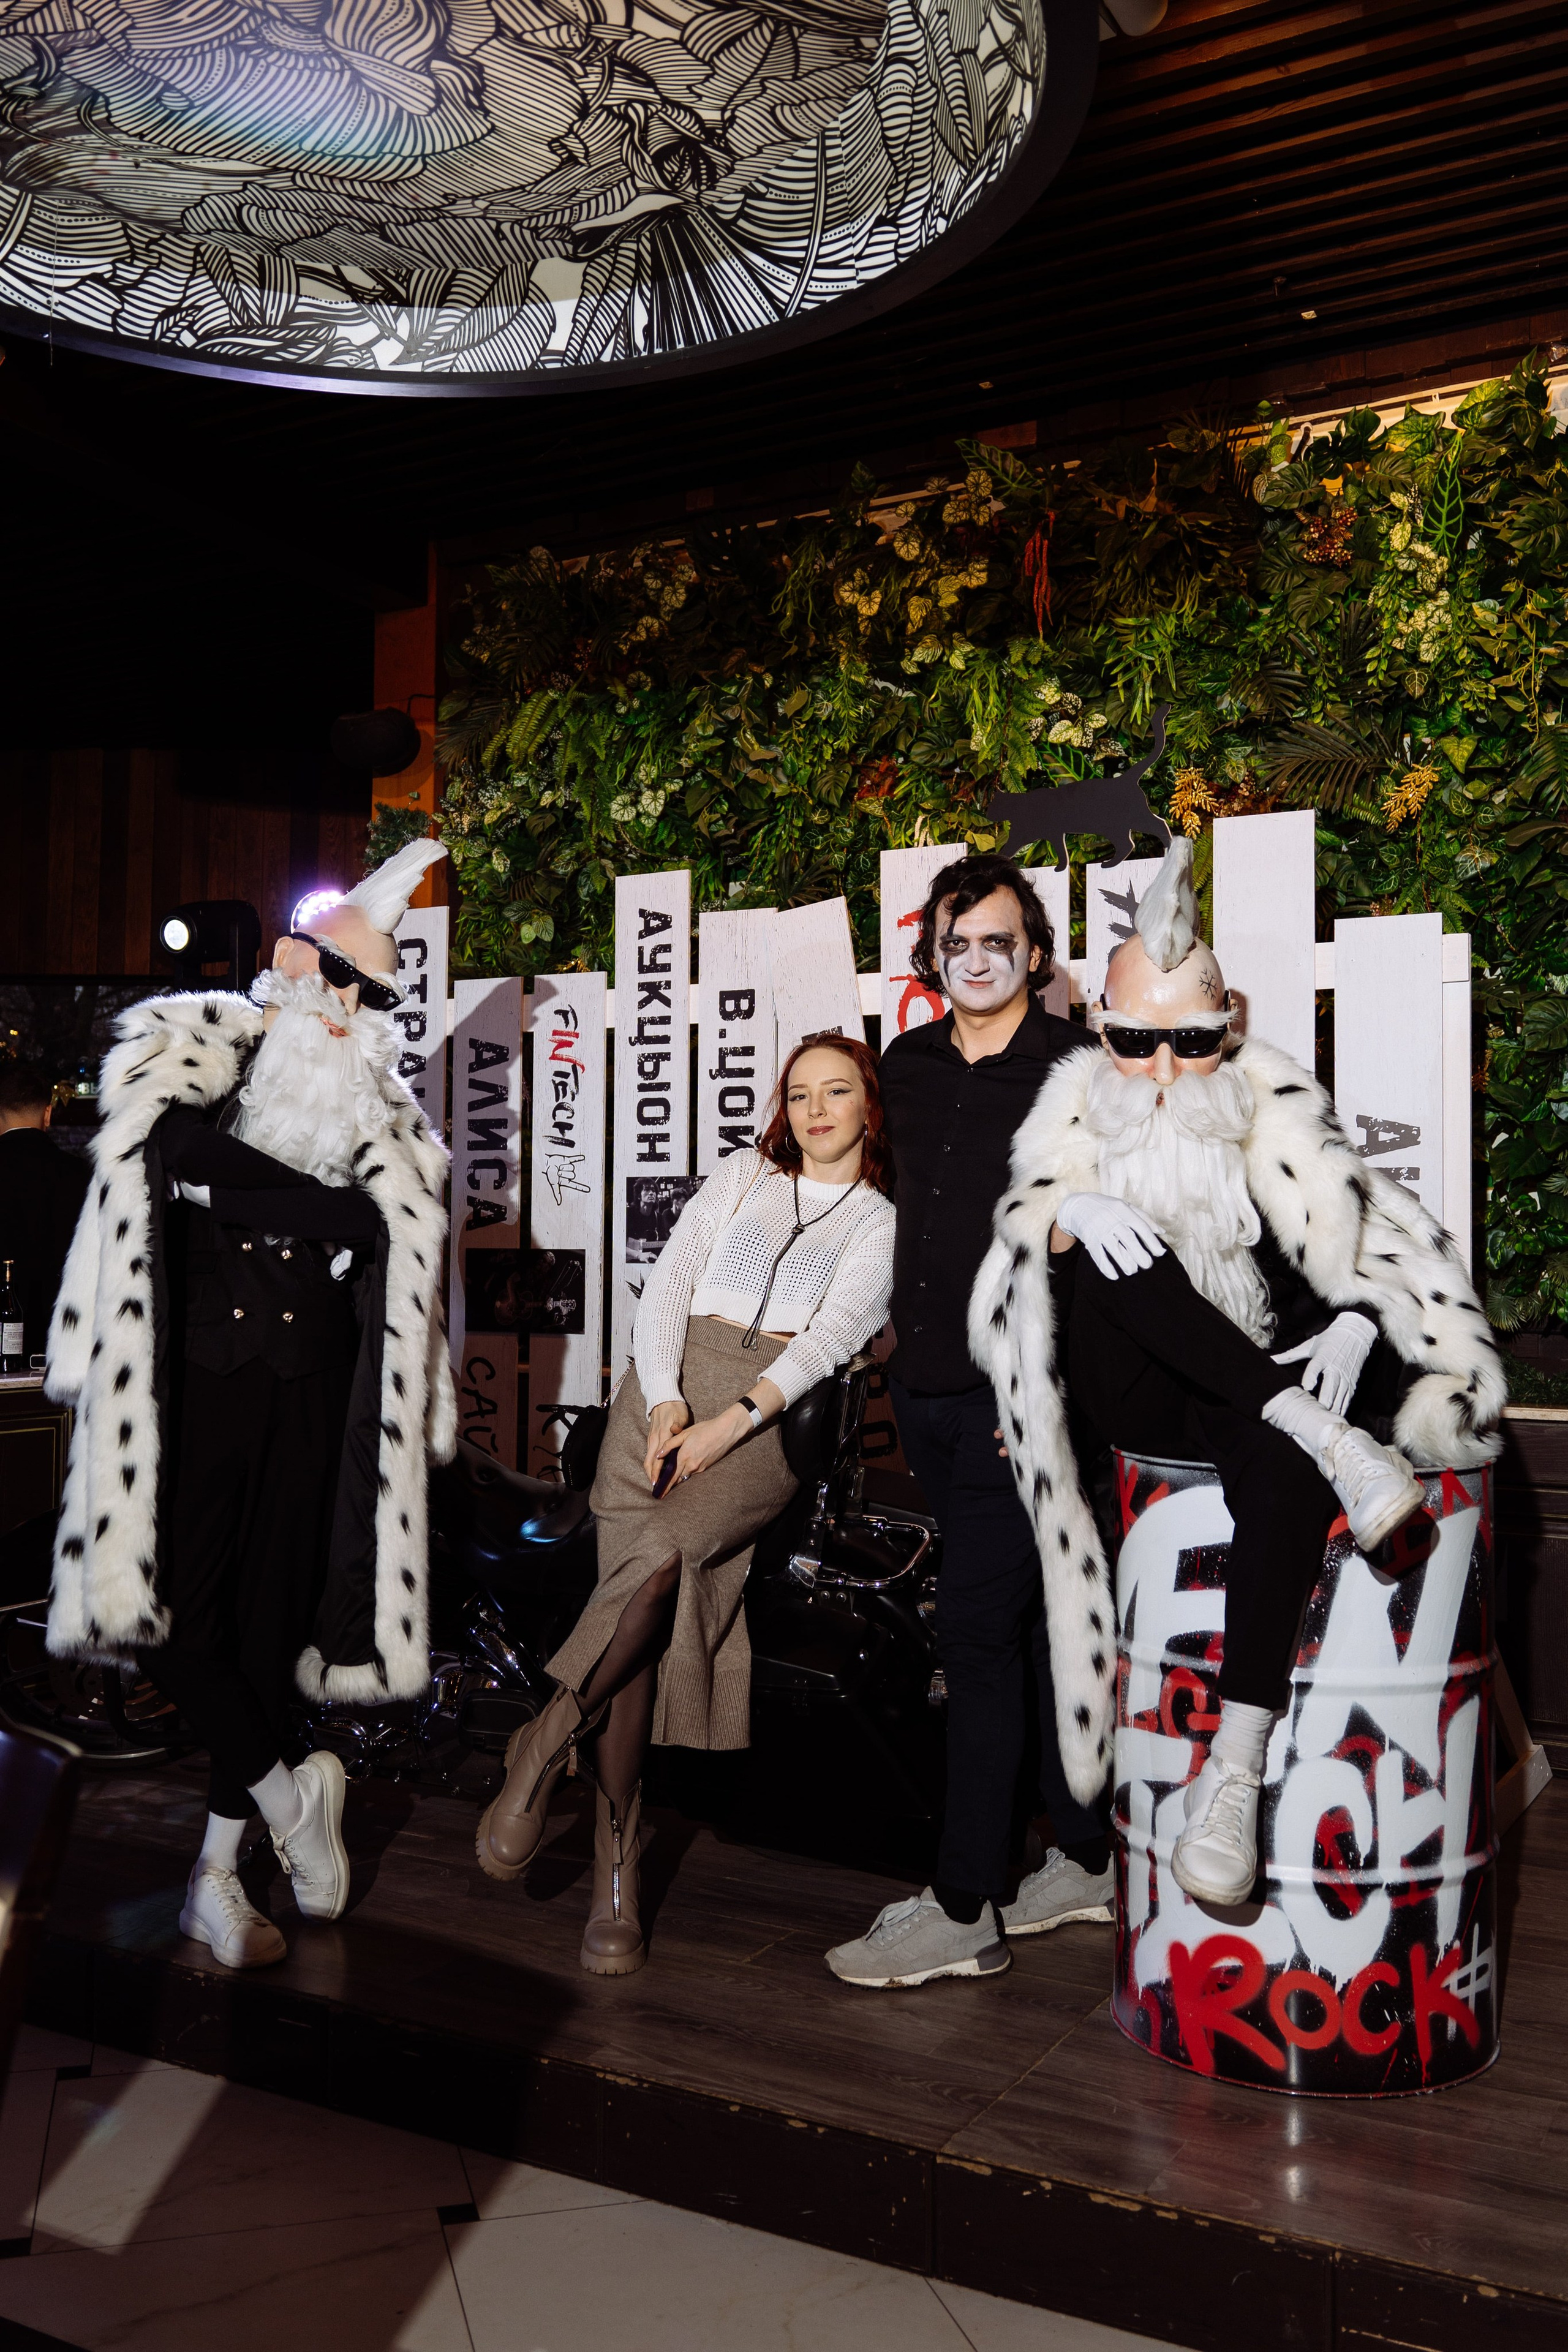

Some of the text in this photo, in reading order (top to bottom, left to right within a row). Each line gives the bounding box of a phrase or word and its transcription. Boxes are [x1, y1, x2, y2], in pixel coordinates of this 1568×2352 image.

[394, 938, 428, 1098] СТРА
[628, 908, 672, 1162] АУКЦЫОН
[466, 1038, 509, 1232] АЛИСА
[1167, 1934, 1480, 2076] ROCK
